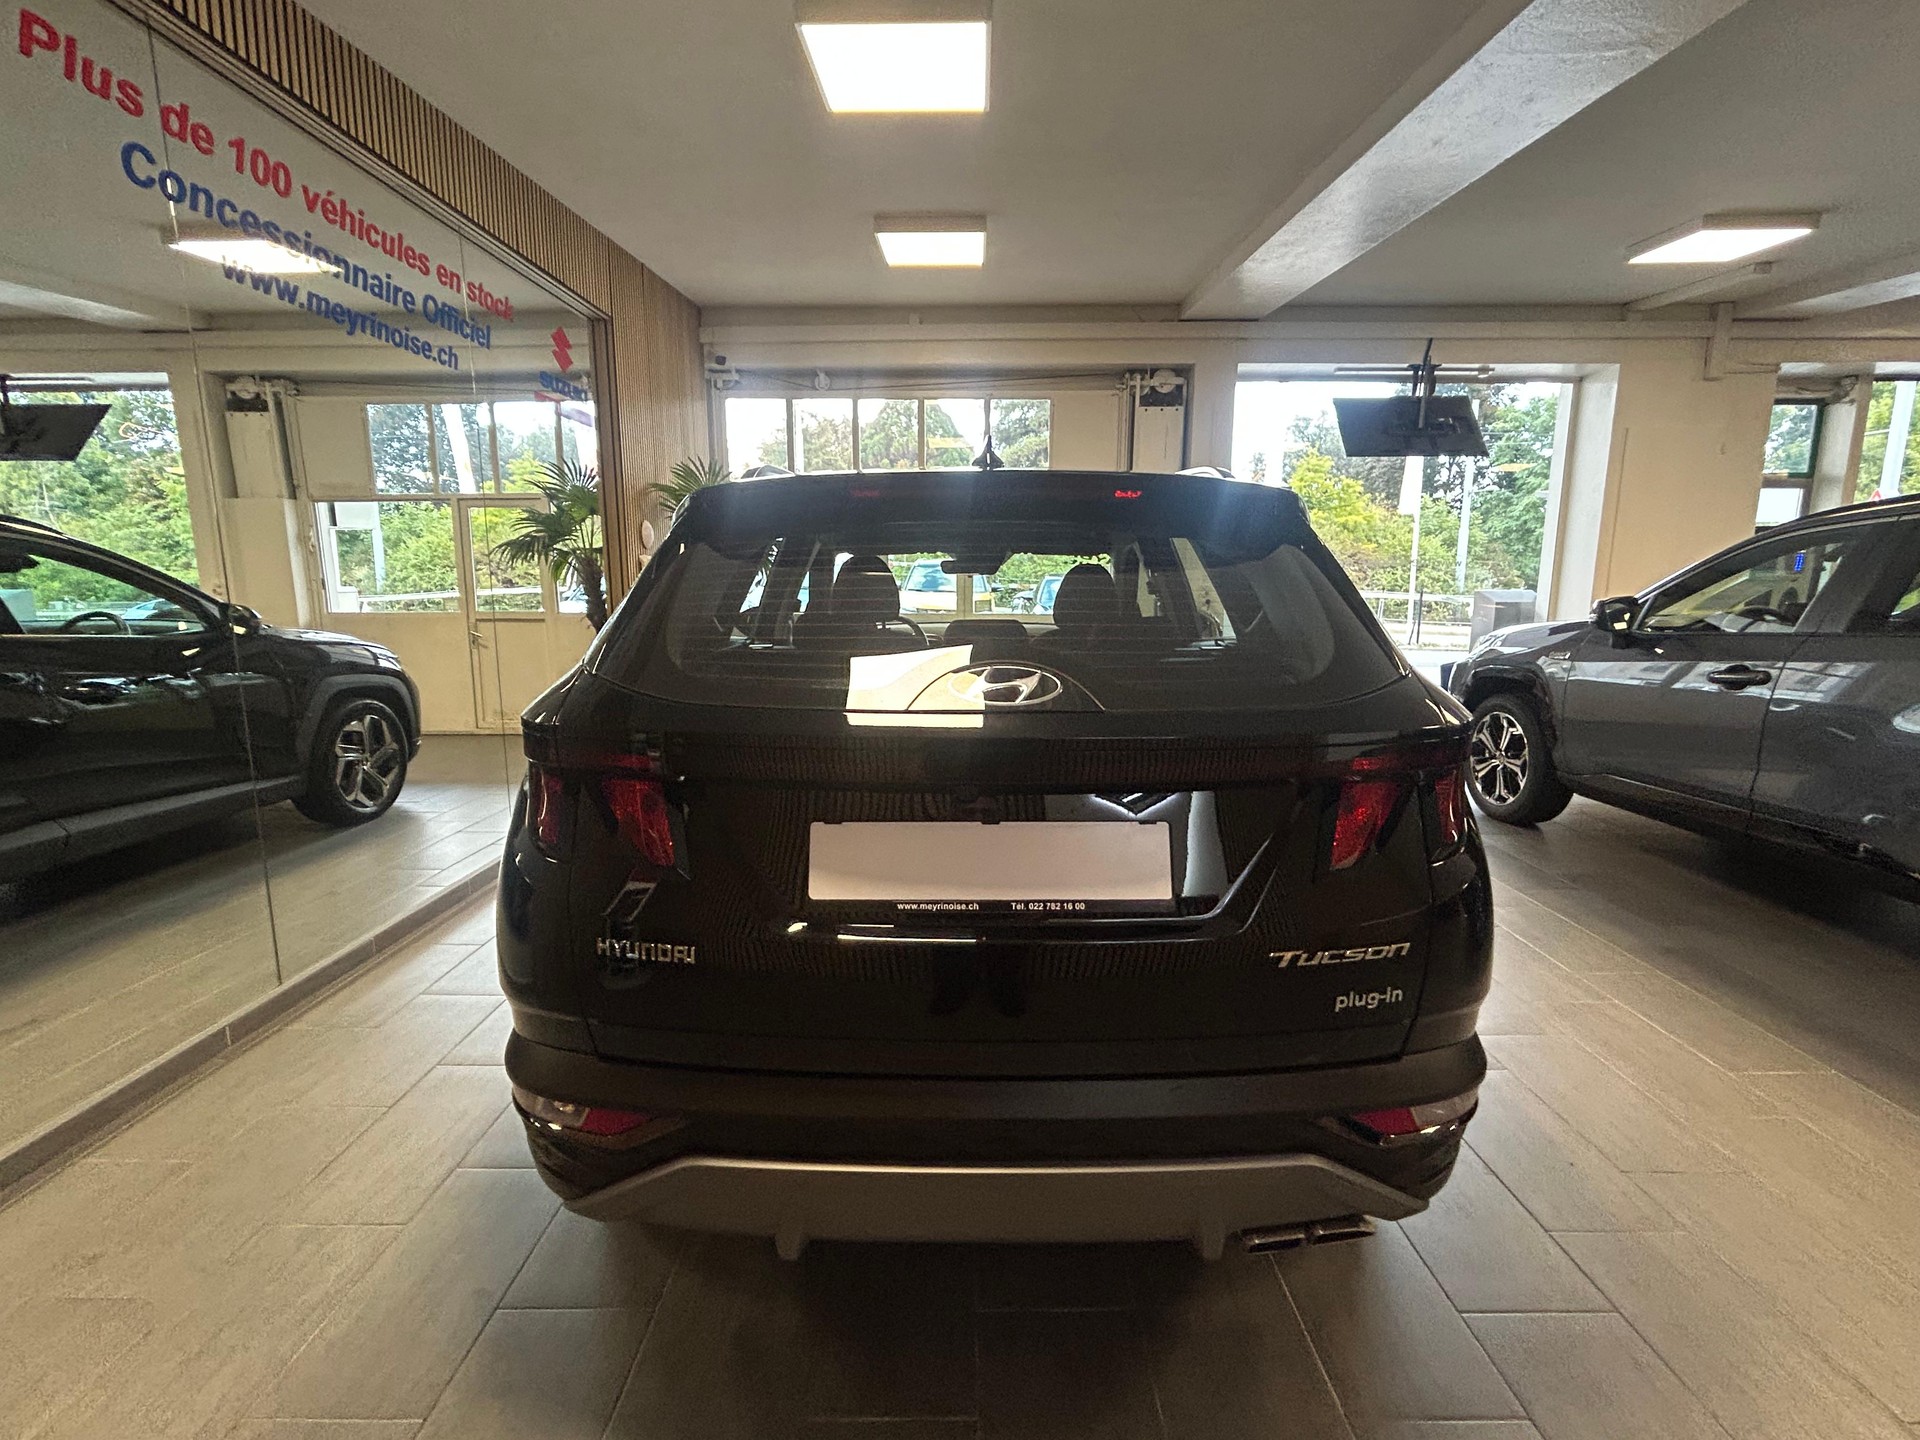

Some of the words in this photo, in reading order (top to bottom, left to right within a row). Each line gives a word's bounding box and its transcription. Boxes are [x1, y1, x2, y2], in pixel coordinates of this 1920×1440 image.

[19, 8, 144, 118] Plus
[160, 102, 215, 156] de
[228, 136, 292, 199] 100
[301, 184, 431, 276] véhicules
[436, 263, 462, 295] en
[466, 280, 515, 323] stock
[120, 141, 417, 314] Concessionnaire
[422, 293, 491, 350] Officiel
[222, 254, 458, 370] www.meyrinoise.ch
[897, 902, 979, 912] www.meyrinoise.ch
[1011, 902, 1026, 911] Tél.
[1028, 902, 1044, 911] 022
[1046, 902, 1061, 911] 782
[1063, 902, 1073, 911] 16
[1075, 902, 1086, 911] 00
[596, 937, 696, 964] HYUNDAI
[1334, 986, 1404, 1013] plug-in
